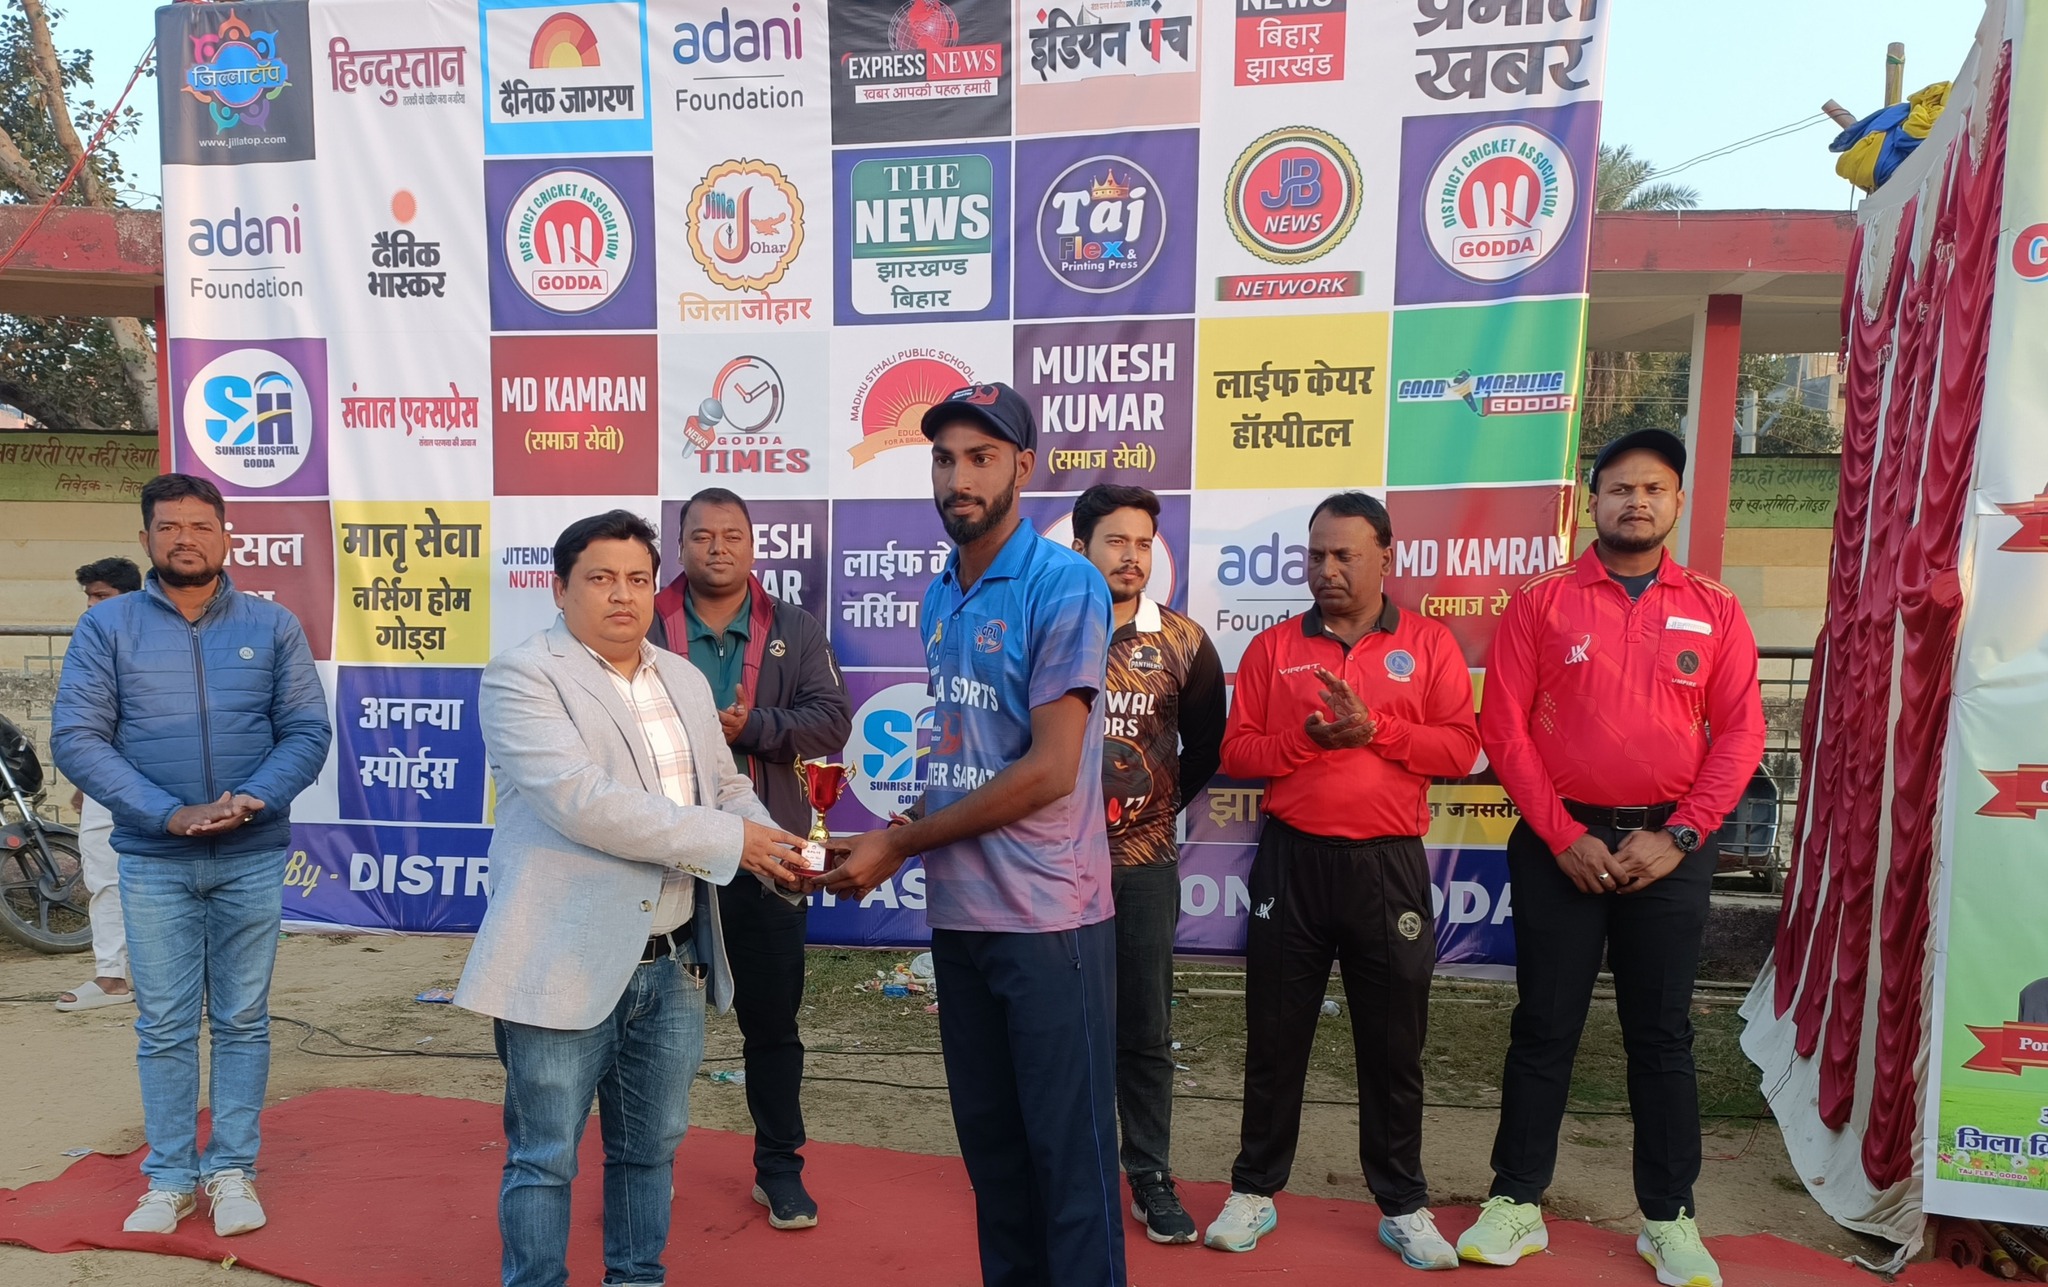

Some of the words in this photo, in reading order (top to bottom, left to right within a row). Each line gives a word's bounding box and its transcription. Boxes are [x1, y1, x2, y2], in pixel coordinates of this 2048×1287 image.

[673, 2, 803, 64] adani
[1029, 8, 1131, 81] इंडियन
[1257, 18, 1323, 49] बिहार
[328, 37, 466, 107] हिन्दुस्तान
[849, 53, 925, 79] EXPRESS
[931, 48, 997, 76] NEWS
[1245, 47, 1334, 83] झारखंड
[1415, 35, 1593, 100] खबर
[500, 79, 555, 116] दैनिक
[559, 83, 634, 114] जागरण
[676, 86, 804, 111] Foundation
[892, 83, 932, 98] आपकी
[963, 79, 992, 95] हमारी
[199, 136, 286, 149] www.jillatop.com
[883, 163, 961, 192] THE
[1260, 157, 1322, 208] JB
[1441, 165, 1465, 229] DISTRICT
[1462, 138, 1517, 168] CRICKET
[1517, 142, 1559, 218] ASSOCIATION
[188, 203, 301, 257] adani
[519, 206, 538, 262] DISTRICT
[533, 184, 578, 209] CRICKET
[580, 187, 619, 260] ASSOCIATION
[855, 193, 990, 244] NEWS
[1052, 187, 1146, 242] Taj
[1264, 213, 1322, 234] NEWS
[371, 229, 440, 267] दैनिक
[1059, 236, 1124, 260] Flex
[1126, 249, 1138, 260] &
[1459, 236, 1534, 258] GODDA
[876, 258, 969, 283] झारखण्ड
[1061, 260, 1105, 273] Printing
[1108, 259, 1138, 270] Press
[190, 276, 303, 299] Foundation
[367, 271, 446, 299] भास्कर
[537, 275, 603, 290] GODDA
[891, 285, 952, 310] बिहार
[1235, 277, 1348, 297] NETWORK
[1033, 343, 1176, 385] MUKESH
[501, 377, 538, 413] MD
[545, 376, 647, 412] KAMRAN
[851, 381, 869, 421] MADHU
[865, 355, 897, 383] STHALI
[898, 348, 937, 361] PUBLIC
[1214, 361, 1301, 402] लाईफ
[1305, 360, 1375, 396] केयर
[1399, 379, 1447, 399] GOOD
[1474, 372, 1564, 395] MORNING
[341, 382, 396, 429] संताल
[400, 382, 478, 437] एक्सप्रेस
[1042, 393, 1165, 433] KUMAR
[525, 428, 579, 454] (समाज
[584, 424, 624, 454] सेवी)
[685, 426, 709, 449] NEWS
[717, 436, 783, 445] GODDA
[906, 436, 931, 445] BRIGH
[1231, 412, 1354, 450] हॉस्पीटल
[215, 446, 257, 456] SUNRISE
[257, 445, 299, 456] HOSPITAL
[243, 457, 275, 469] GODDA
[694, 448, 810, 474] TIMES
[1048, 448, 1106, 474] (समाज
[1112, 442, 1156, 472] सेवी)
[223, 521, 304, 567] ंसल
[414, 507, 482, 558] सेवा
[752, 523, 812, 559] ESH
[842, 540, 925, 581] लाईफ
[1217, 532, 1308, 586] ada
[1395, 540, 1439, 577] MD
[1446, 535, 1567, 576] KAMRAN
[427, 577, 472, 617] होम
[1420, 593, 1485, 617] (समाज
[1489, 588, 1511, 616] से
[1278, 662, 1321, 675] VIRAT
[949, 676, 999, 712] SORTS
[1105, 689, 1155, 716] WAL
[359, 696, 464, 730] अनन्या
[870, 781, 913, 791] SUNRISE
[283, 850, 321, 897] By
[1958, 1127, 2021, 1155] जिला
[1958, 1168, 1974, 1176] TAJ
[1999, 1173, 2029, 1182] GODDA
